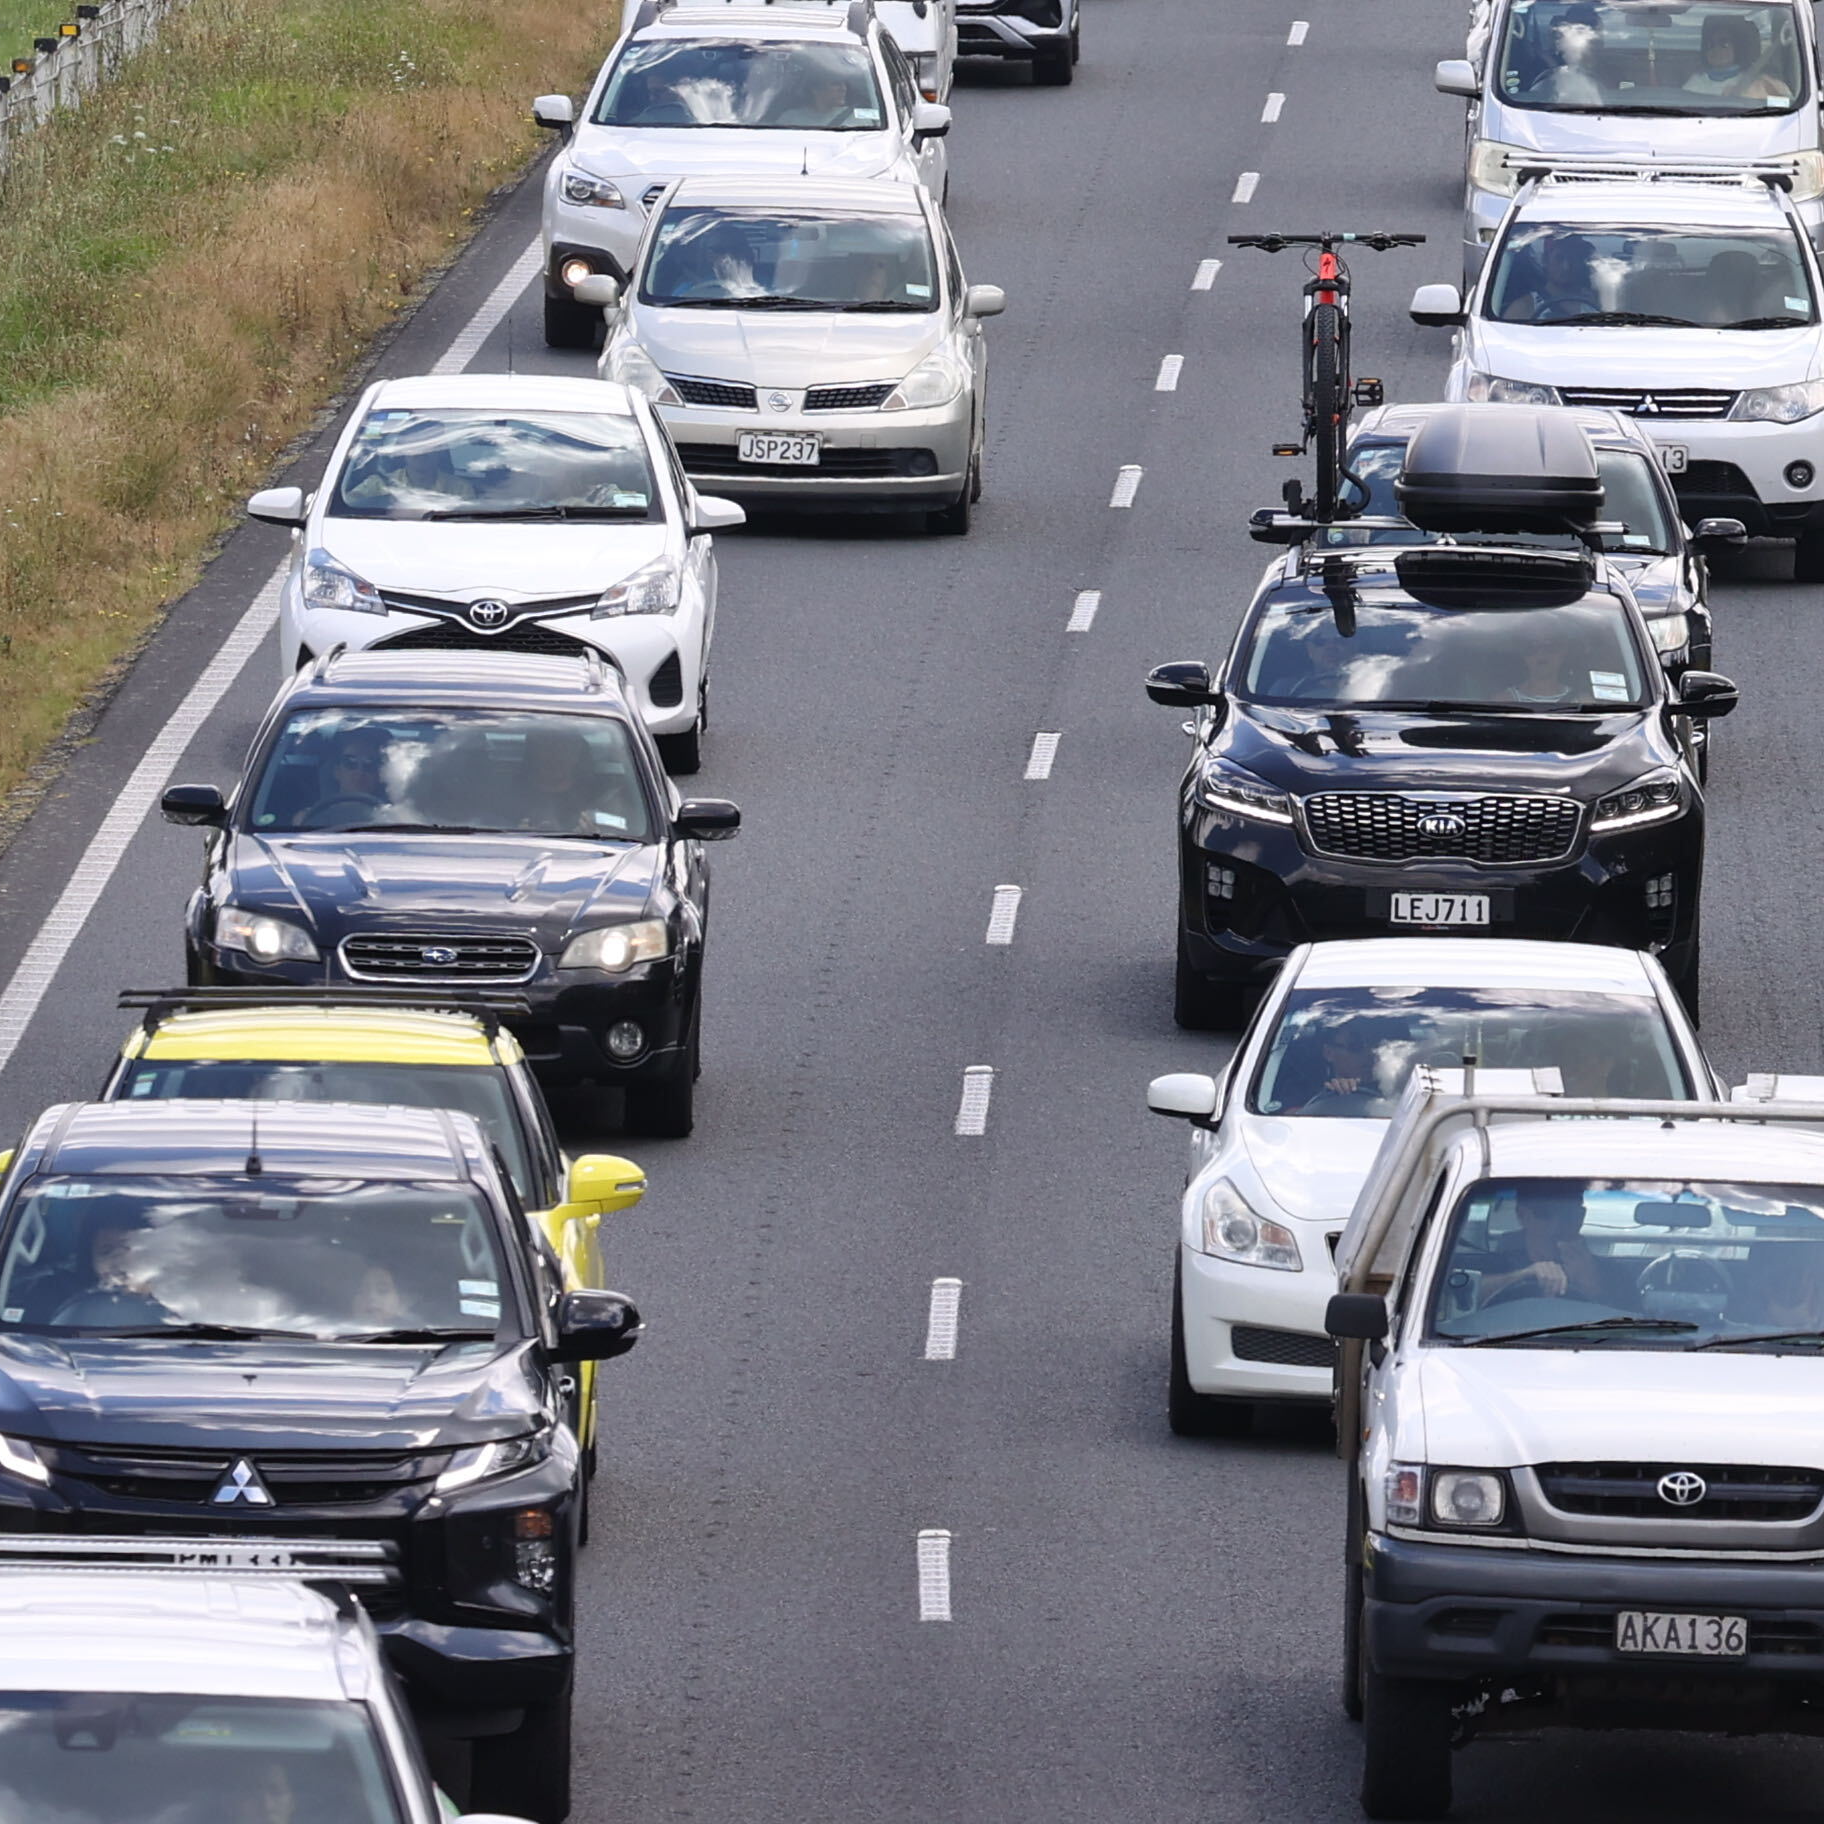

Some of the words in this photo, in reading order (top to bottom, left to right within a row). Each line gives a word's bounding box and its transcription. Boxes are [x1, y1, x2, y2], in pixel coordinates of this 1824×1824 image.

[742, 438, 816, 461] JSP237
[1425, 819, 1458, 834] KIA
[1394, 897, 1484, 922] LEJ711
[1618, 1616, 1745, 1655] AKA136
